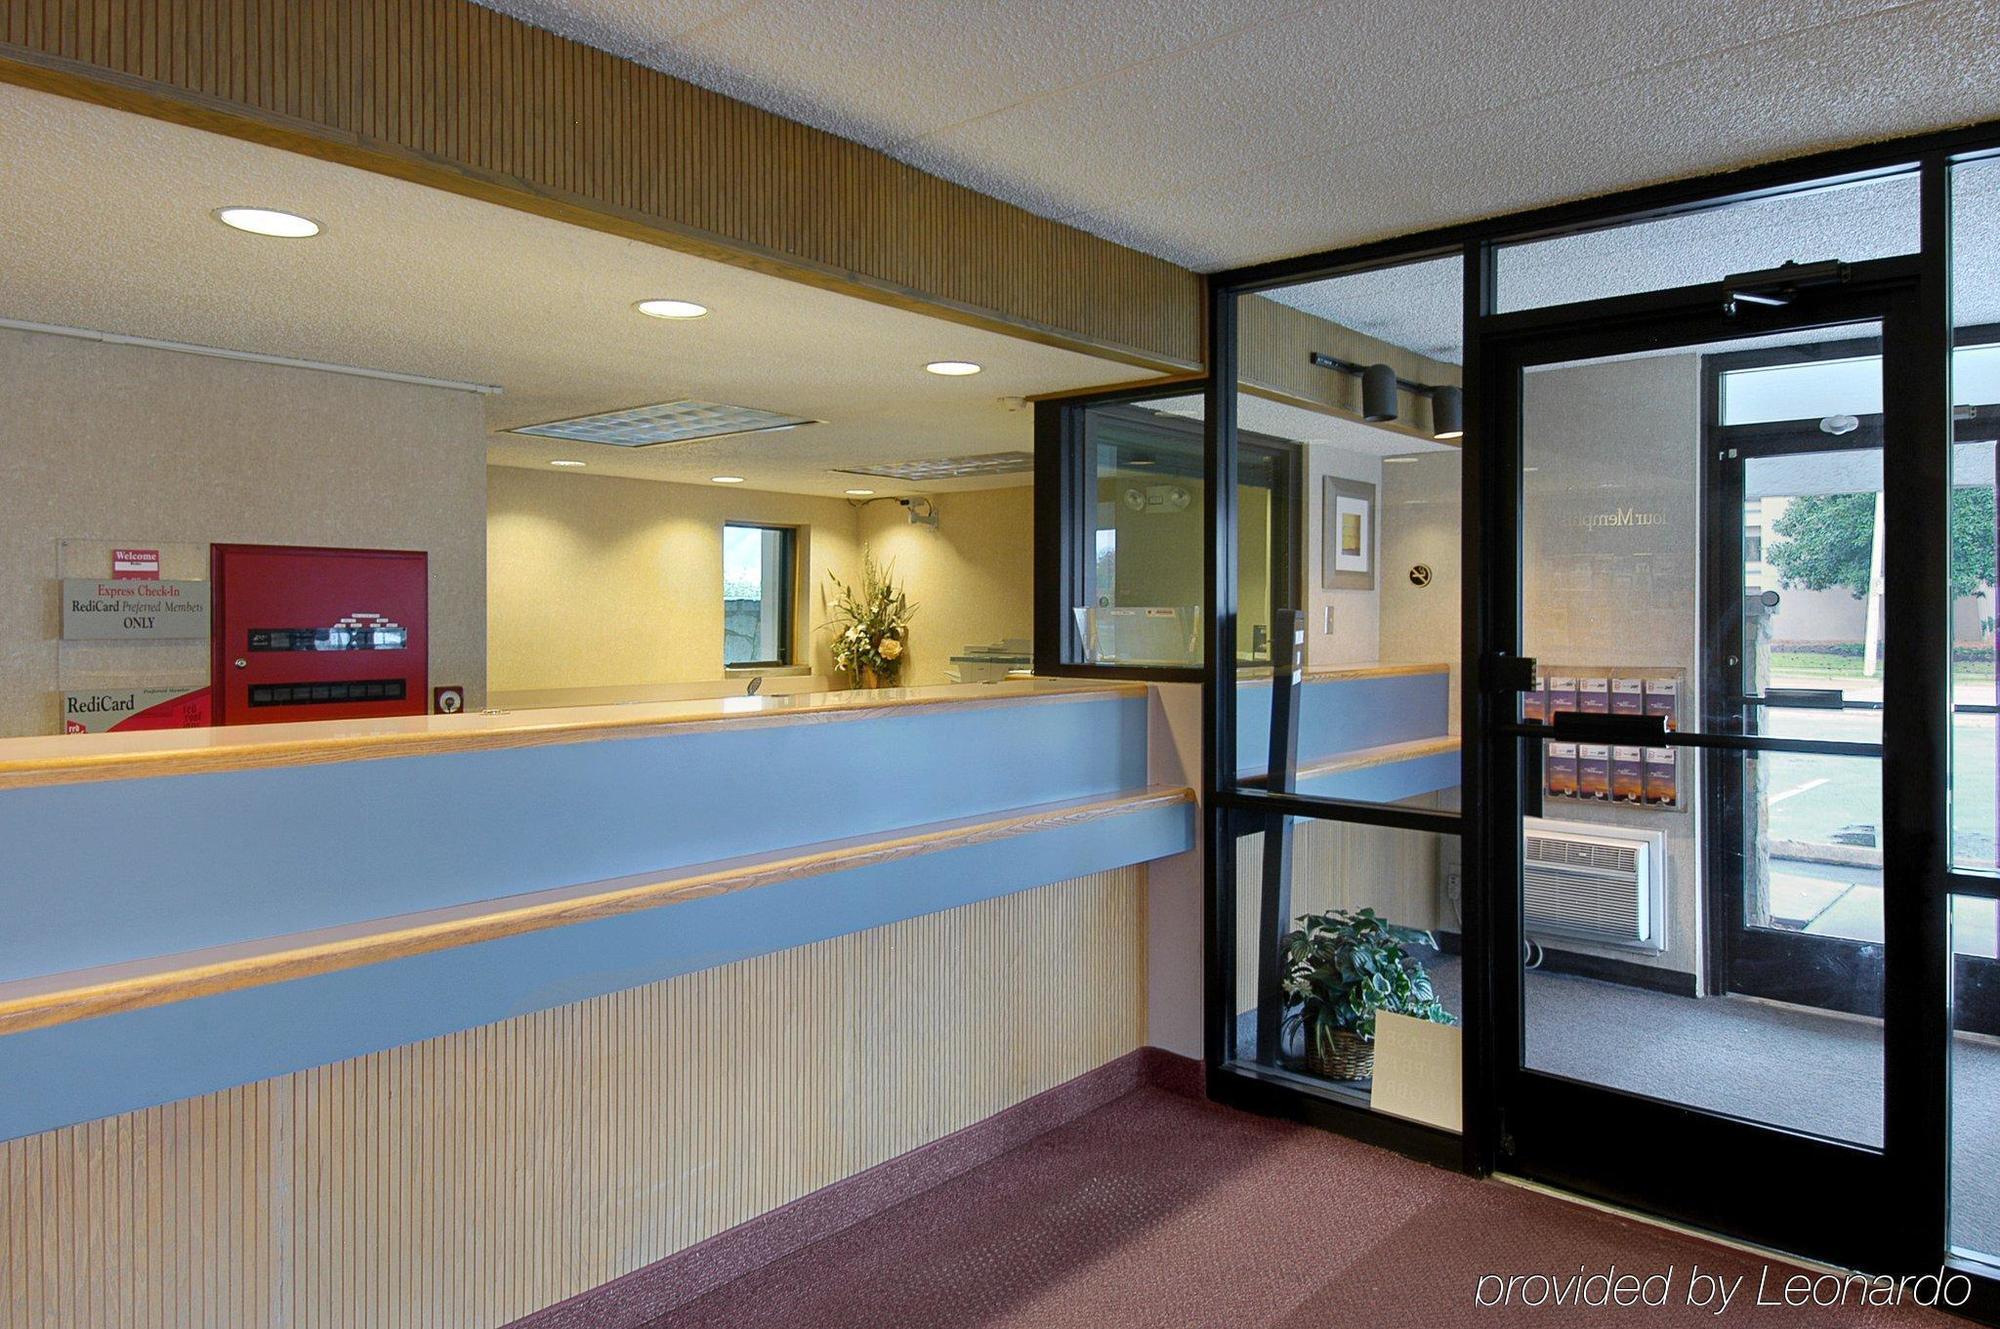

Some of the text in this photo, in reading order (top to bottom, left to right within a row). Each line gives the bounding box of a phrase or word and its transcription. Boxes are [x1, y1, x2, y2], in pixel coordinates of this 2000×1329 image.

[115, 551, 157, 560] Welcome
[98, 584, 180, 598] Express Check-In
[72, 600, 203, 615] RediCard Preferred Members
[123, 617, 155, 629] ONLY
[67, 695, 135, 713] RediCard
